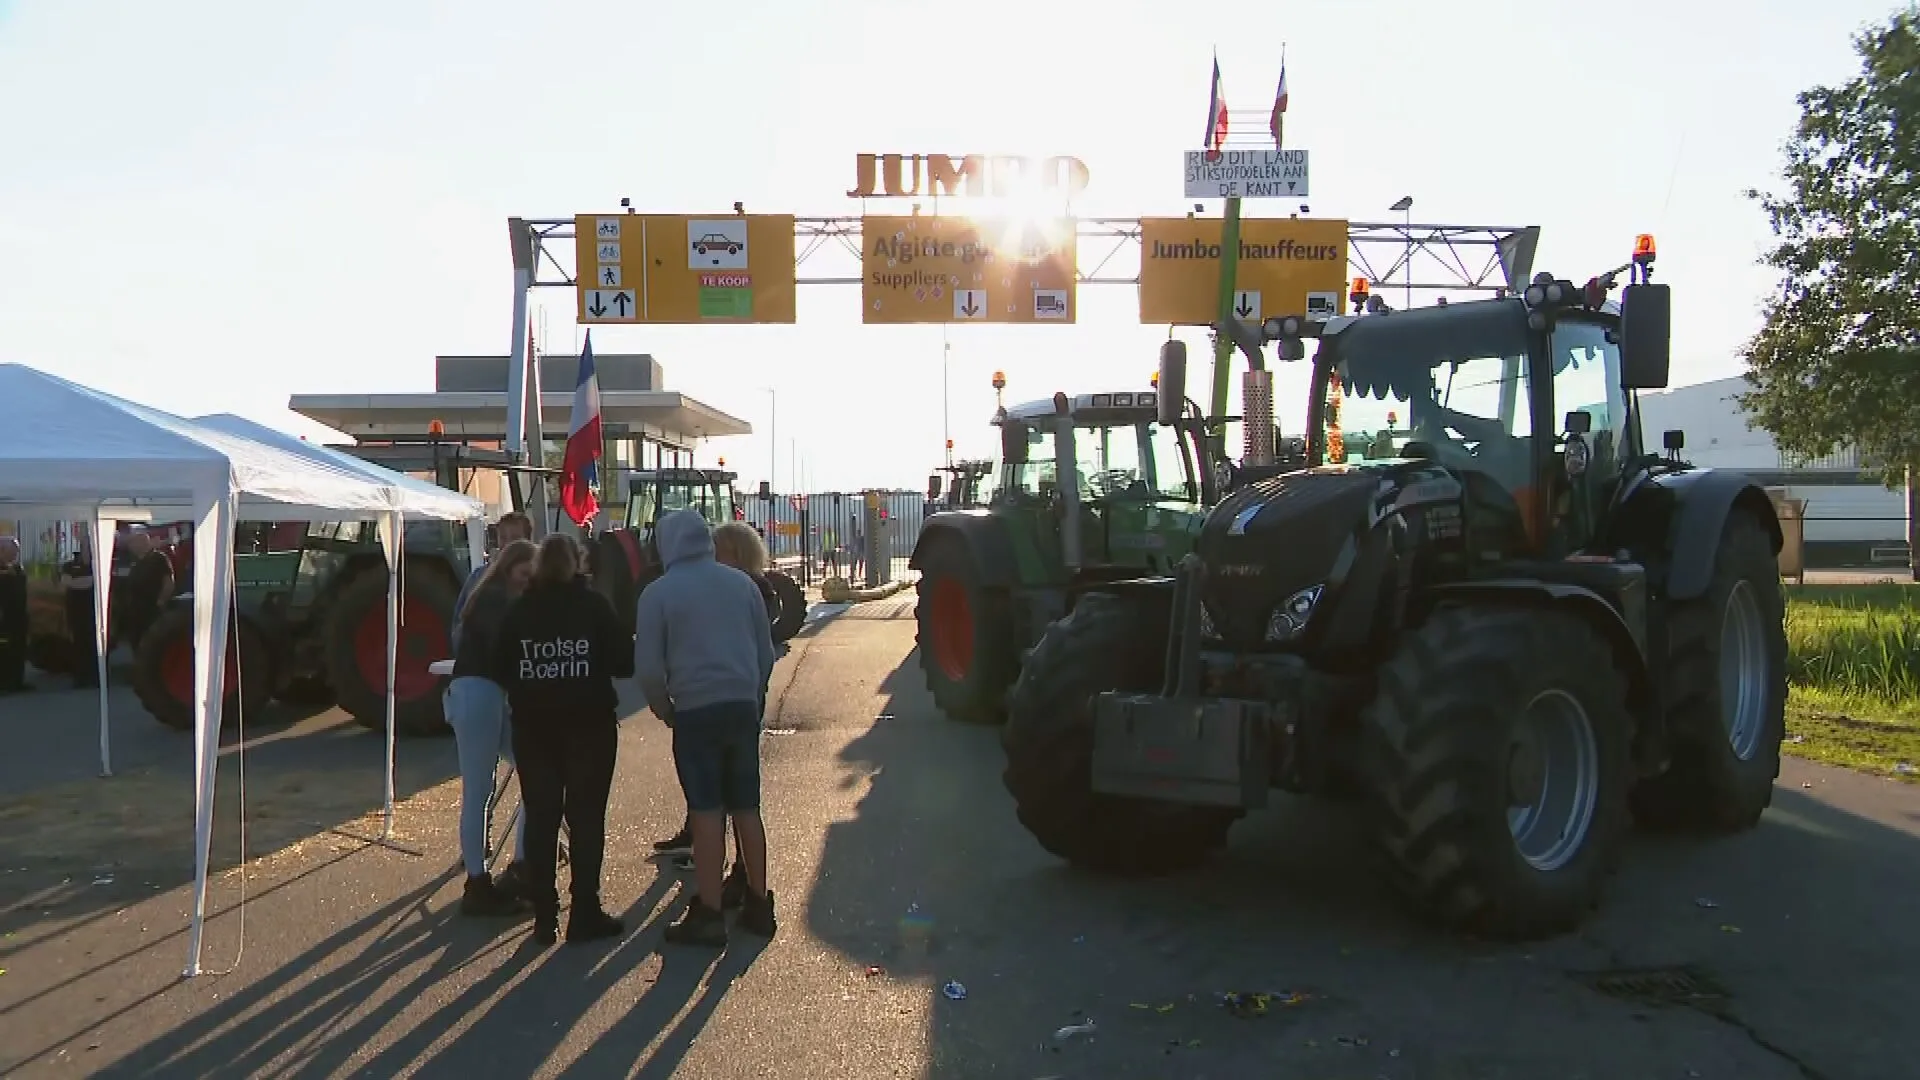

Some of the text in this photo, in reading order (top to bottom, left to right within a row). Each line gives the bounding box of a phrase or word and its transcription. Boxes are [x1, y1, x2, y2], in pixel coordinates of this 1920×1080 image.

[1229, 151, 1255, 165] DIT
[1264, 151, 1304, 165] LAND
[1283, 164, 1307, 178] AAN
[1219, 182, 1238, 197] DE
[1246, 181, 1282, 197] KANT
[1150, 237, 1338, 261] Jumbo hauffeurs
[718, 275, 750, 287] KOOP
[872, 270, 946, 289] Suppliers
[520, 636, 590, 658] Trotse
[519, 656, 590, 679] Boerin
